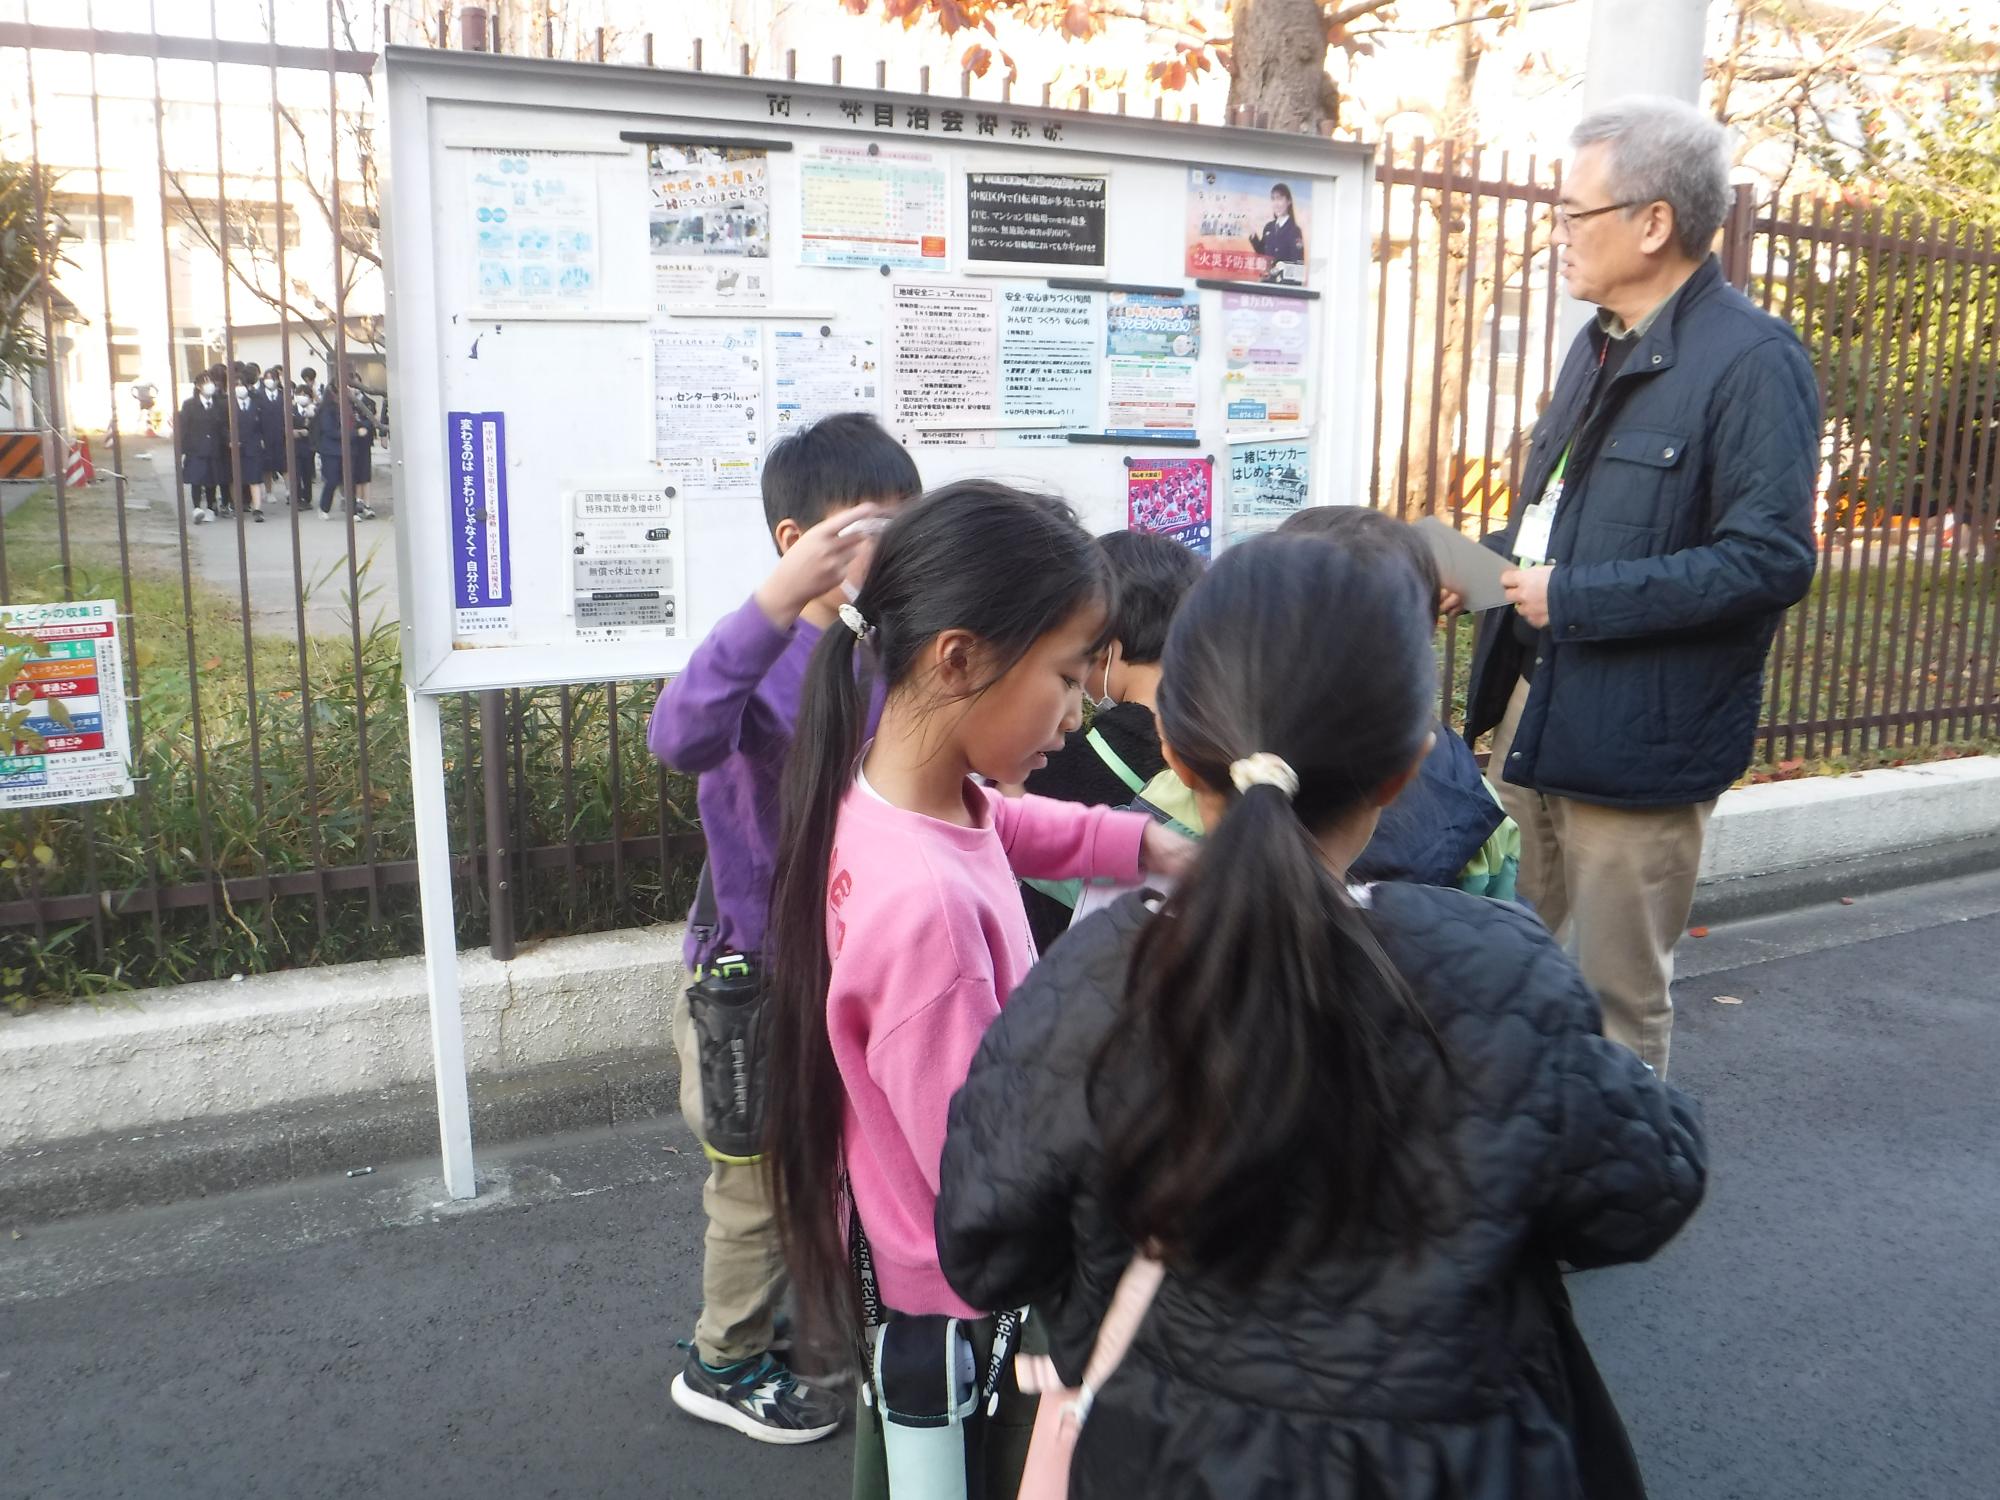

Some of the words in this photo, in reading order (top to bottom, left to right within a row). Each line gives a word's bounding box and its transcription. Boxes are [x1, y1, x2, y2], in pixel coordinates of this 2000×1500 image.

[899, 288, 956, 297] 地域安全ニュース
[676, 392, 736, 401] センターまつり
[459, 419, 475, 472] 変わるのは
[1232, 448, 1306, 464] 一緒にサッカー
[1232, 464, 1284, 480] はじめよう
[585, 493, 662, 502] 国際電話番号による
[462, 475, 478, 558] まわりじゃなくて
[589, 566, 661, 576] 無償で休止できます
[466, 560, 480, 604] 自分から
[731, 1039, 747, 1113] SAHARA
